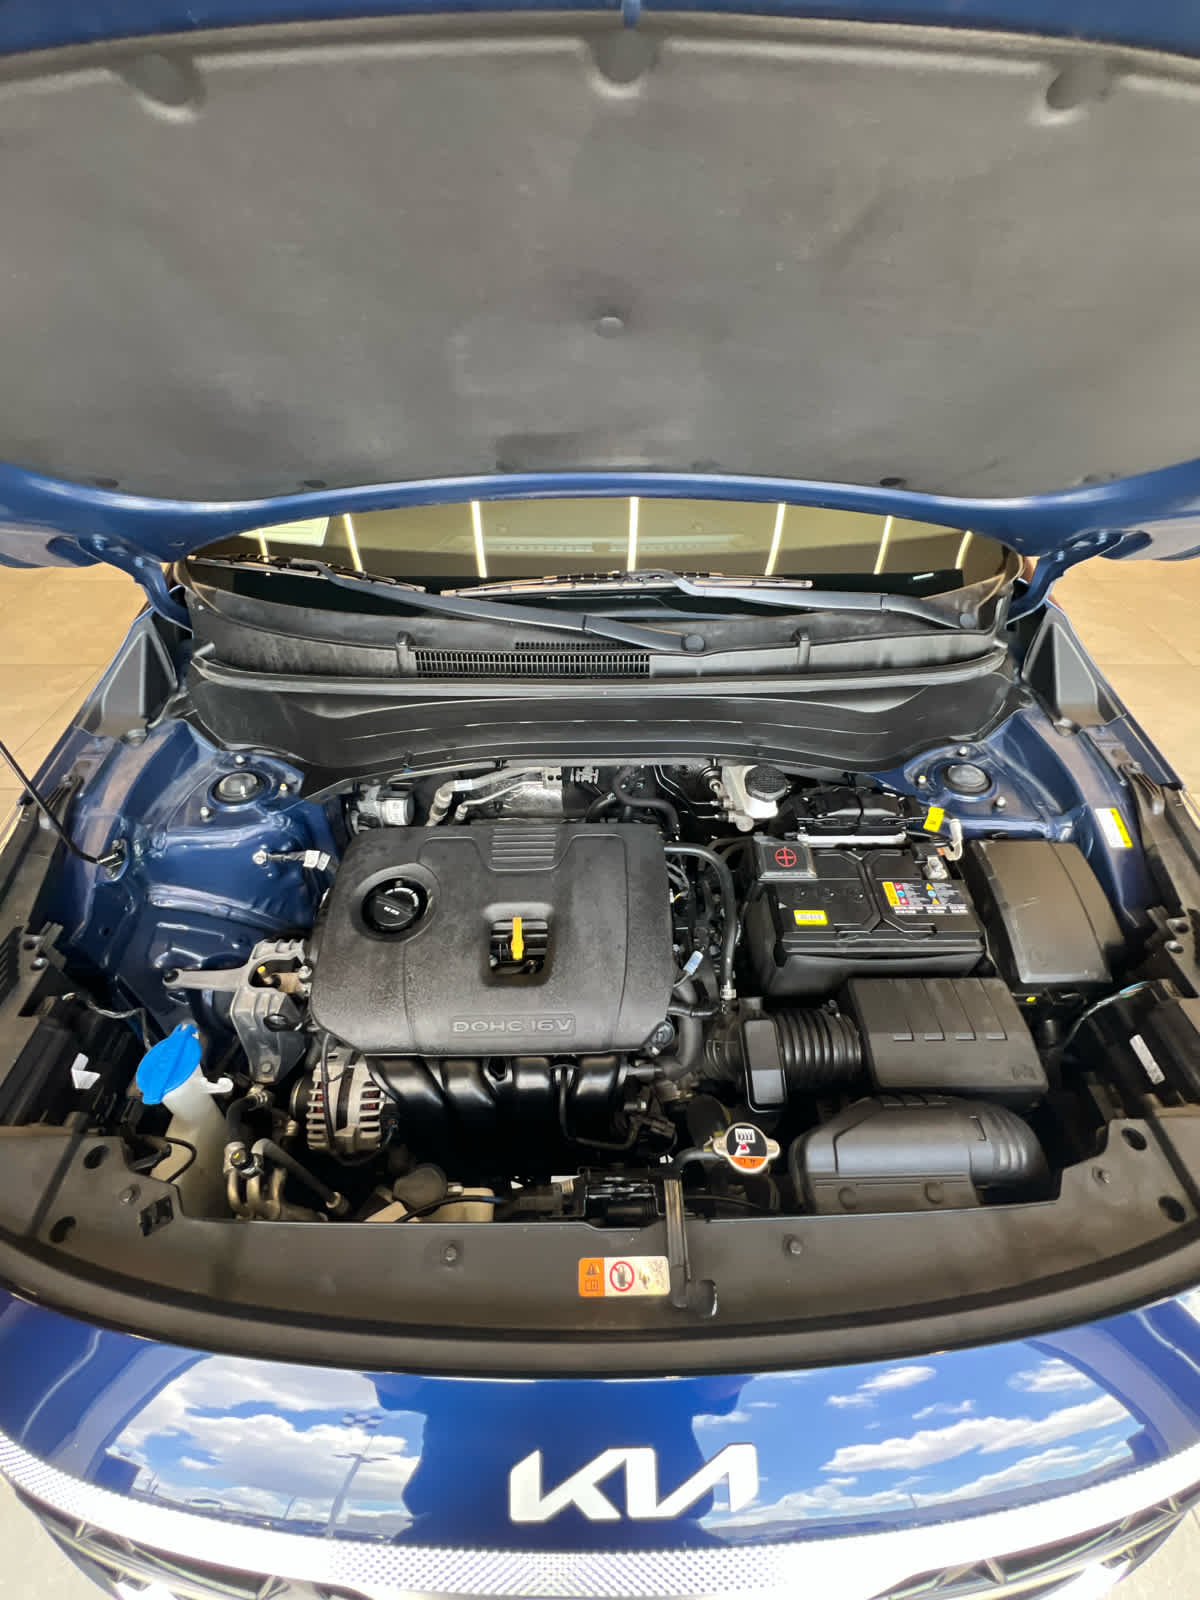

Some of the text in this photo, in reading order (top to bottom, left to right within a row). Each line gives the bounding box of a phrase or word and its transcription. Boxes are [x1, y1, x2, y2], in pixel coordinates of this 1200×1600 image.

[452, 1018, 572, 1033] DOHC 16V
[509, 1442, 759, 1522] KIA
